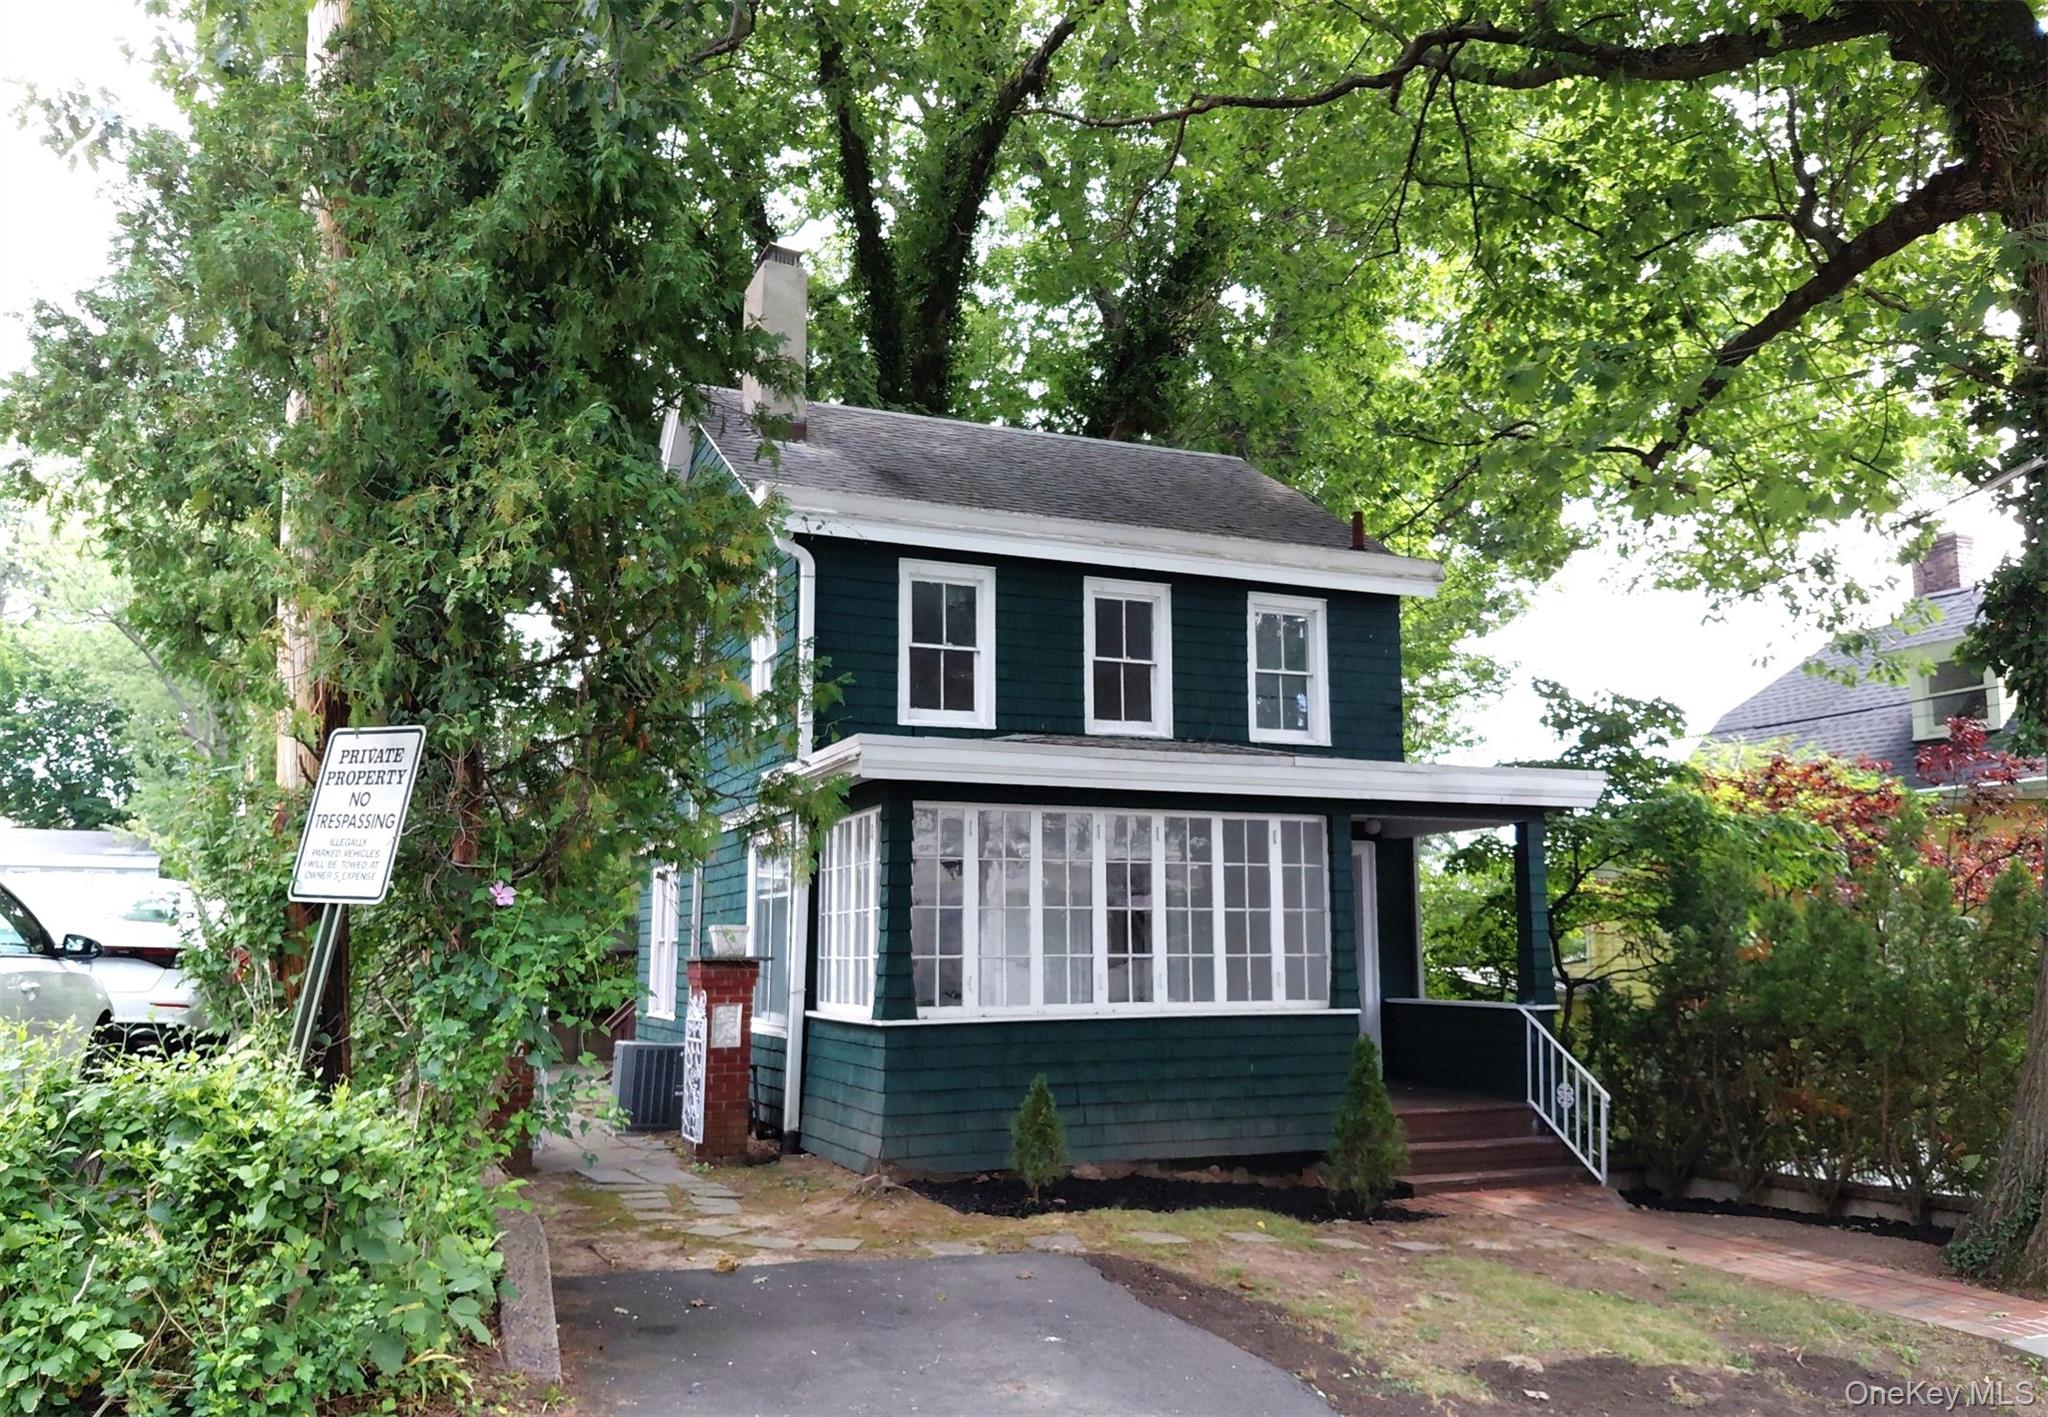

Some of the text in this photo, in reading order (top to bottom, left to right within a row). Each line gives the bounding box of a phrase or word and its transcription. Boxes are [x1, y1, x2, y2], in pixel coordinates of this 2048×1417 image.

[339, 748, 405, 764] PRIVATE
[325, 769, 407, 786] PROPERTY
[349, 791, 371, 807] NO
[315, 813, 396, 829] TRESPASSING
[312, 849, 381, 858] PARKED VEHICLES
[327, 860, 338, 869] BE
[341, 860, 368, 869] TOWED
[369, 861, 380, 869] AT
[304, 871, 339, 880] OWNERS
